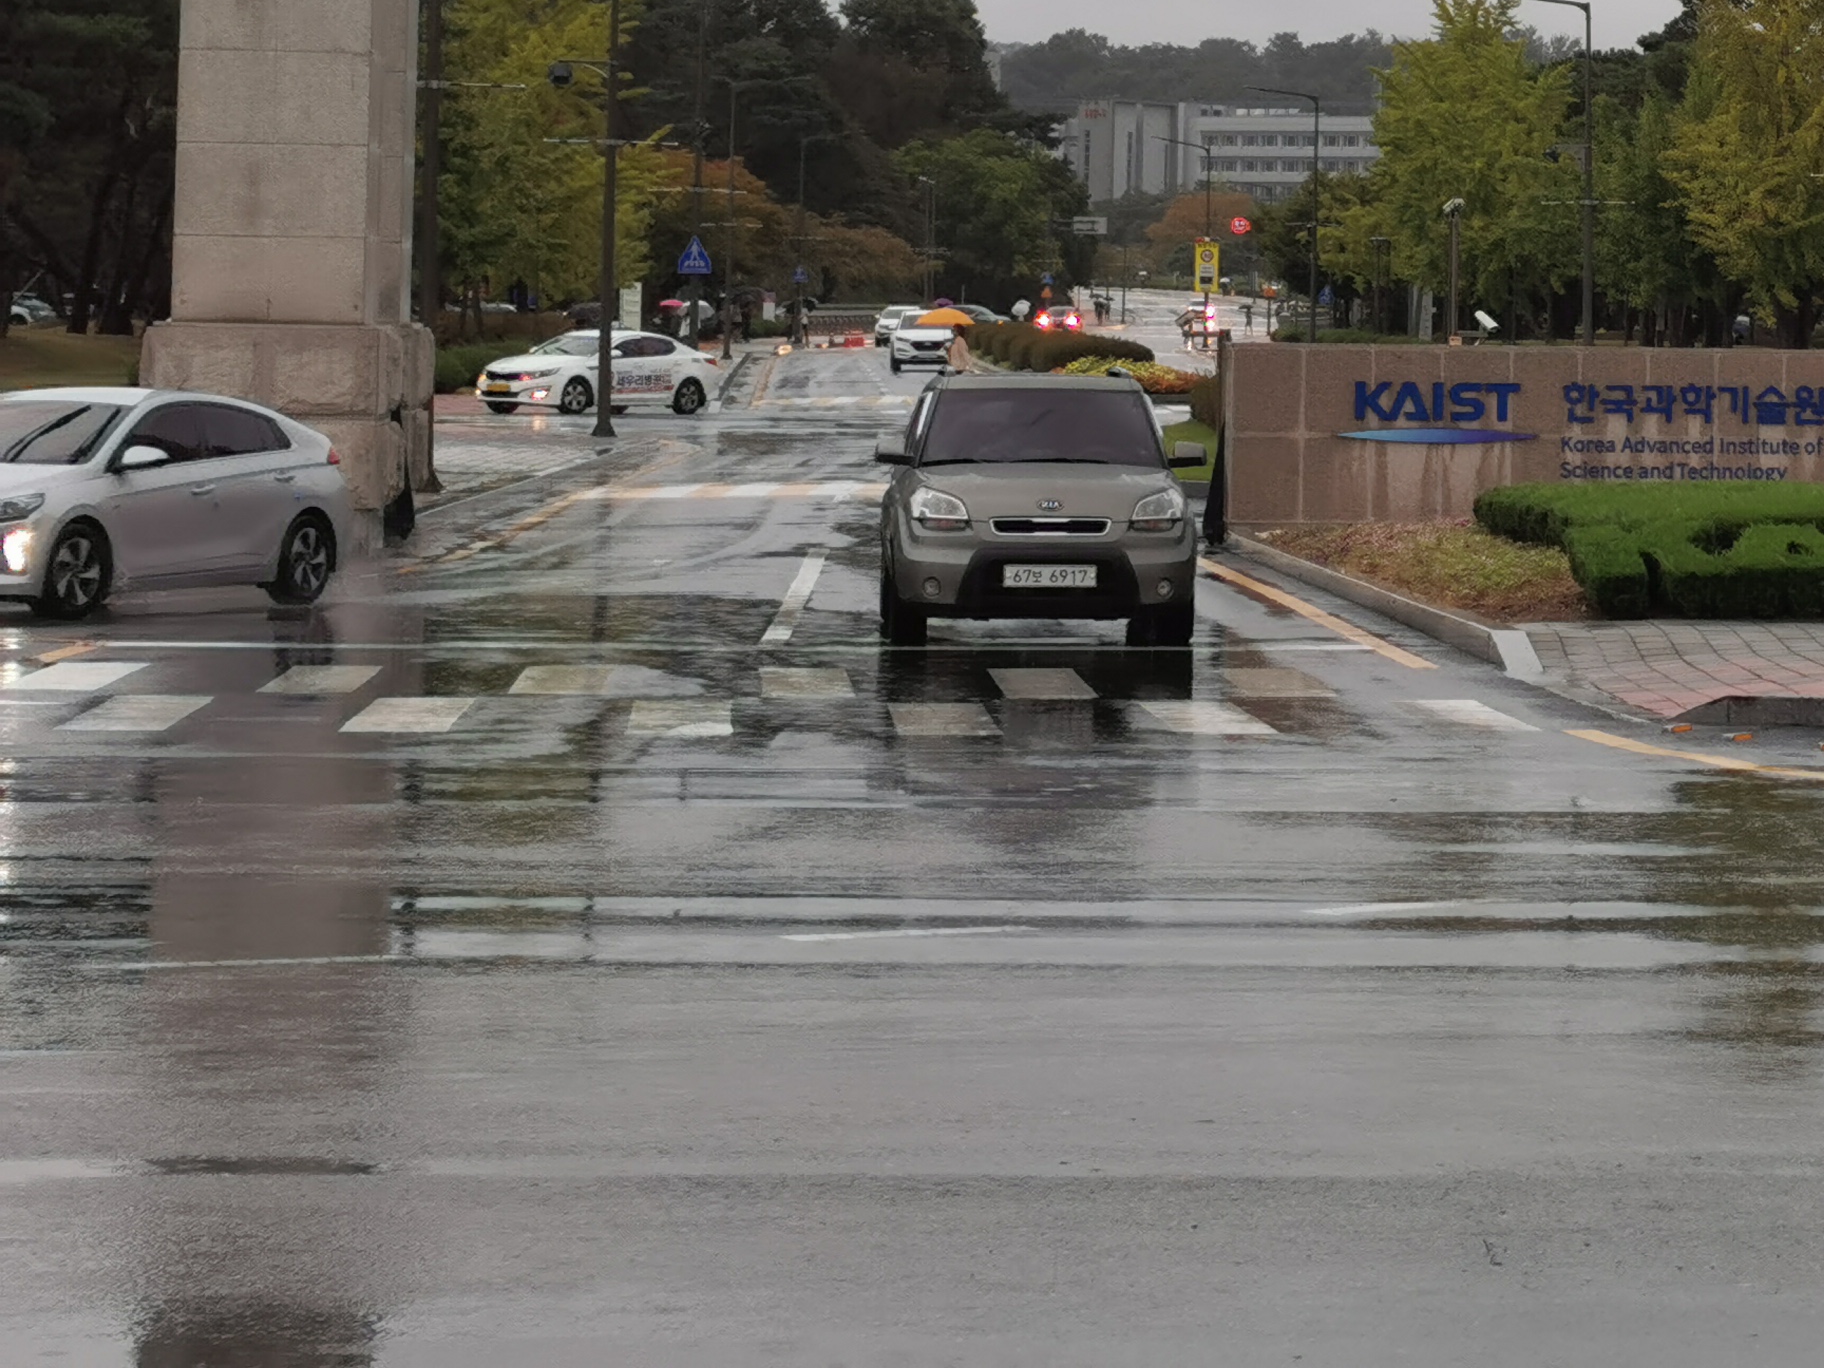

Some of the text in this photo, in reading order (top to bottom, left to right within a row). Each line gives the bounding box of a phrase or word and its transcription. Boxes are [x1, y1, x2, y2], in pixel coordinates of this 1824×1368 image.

[1354, 381, 1521, 422] KAIST
[1560, 435, 1823, 455] Korea Advanced Institute of
[1560, 461, 1788, 481] Science and Technology
[1012, 569, 1088, 586] 67보 6917
